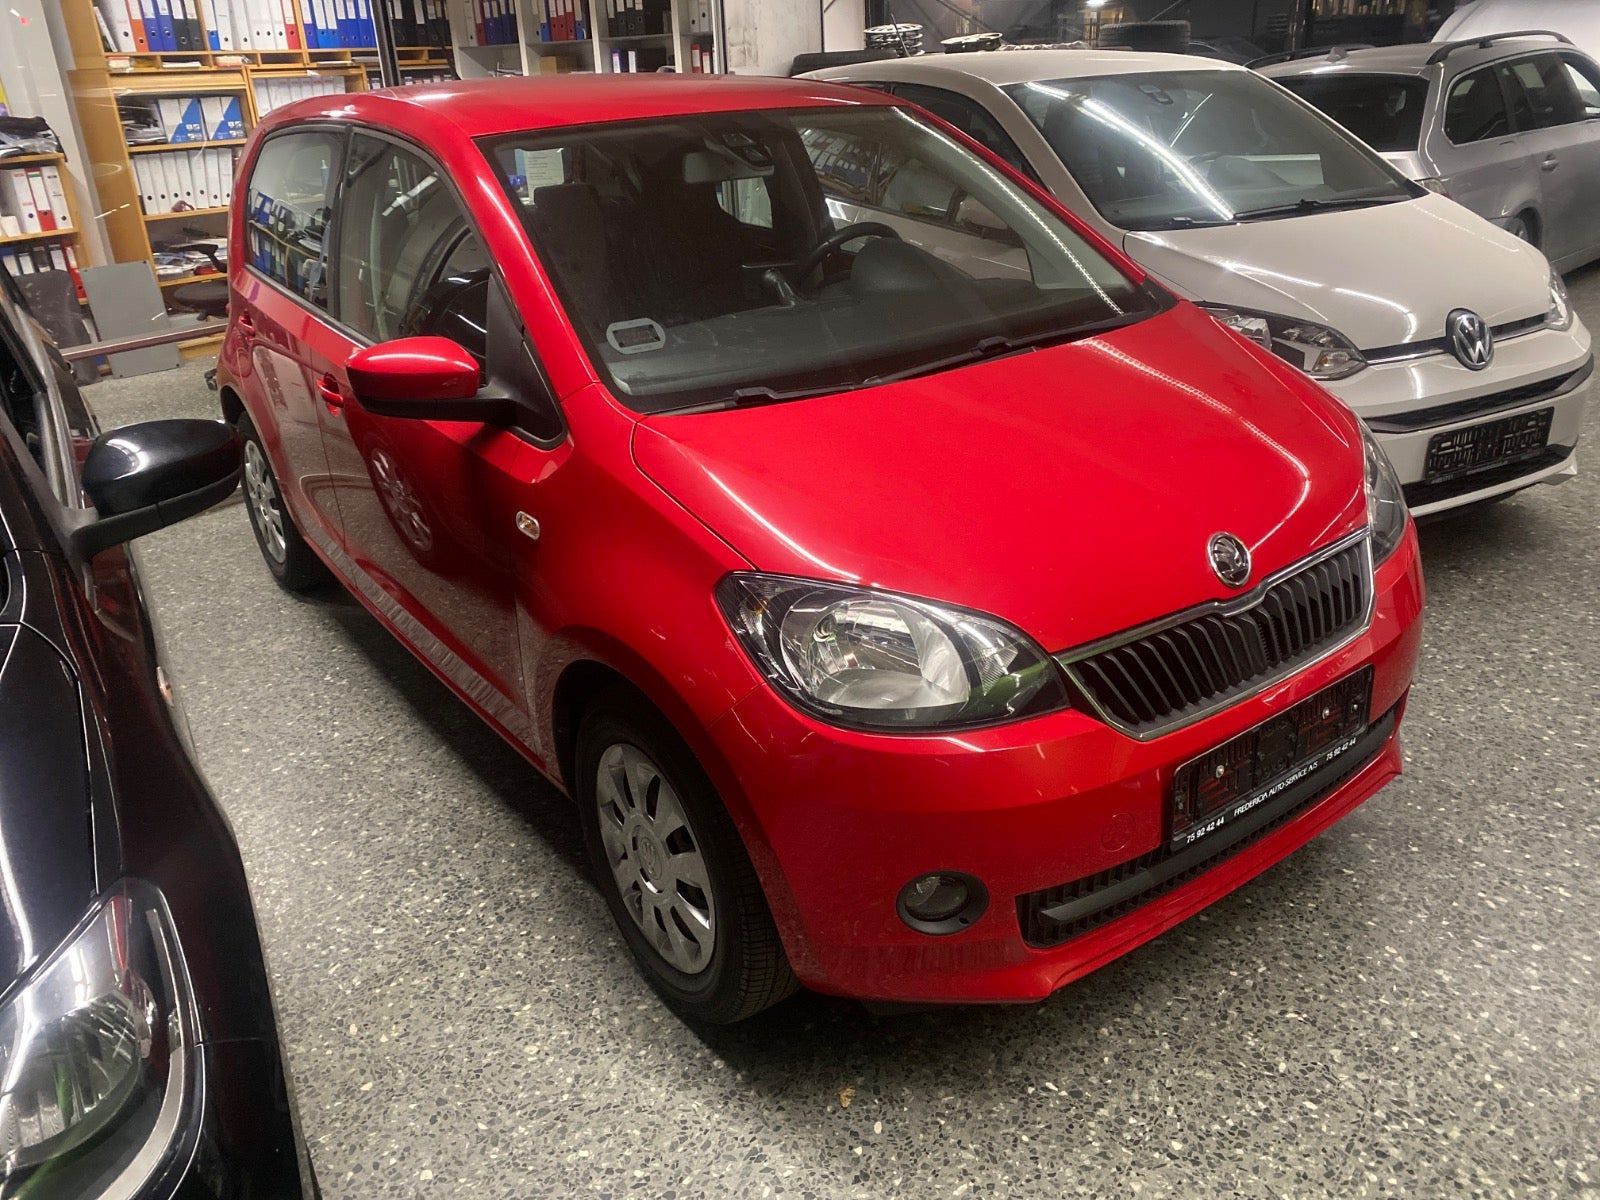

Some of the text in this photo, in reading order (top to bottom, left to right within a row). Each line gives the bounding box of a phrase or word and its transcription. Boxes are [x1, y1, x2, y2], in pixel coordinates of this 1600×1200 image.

[1454, 314, 1491, 366] VW
[1186, 832, 1196, 844] 75
[1196, 827, 1206, 838] 92
[1206, 821, 1215, 832] 42
[1216, 816, 1225, 826] 44
[1233, 792, 1268, 817] FREDERICIA
[1268, 767, 1308, 797] AUTO-SERVICE
